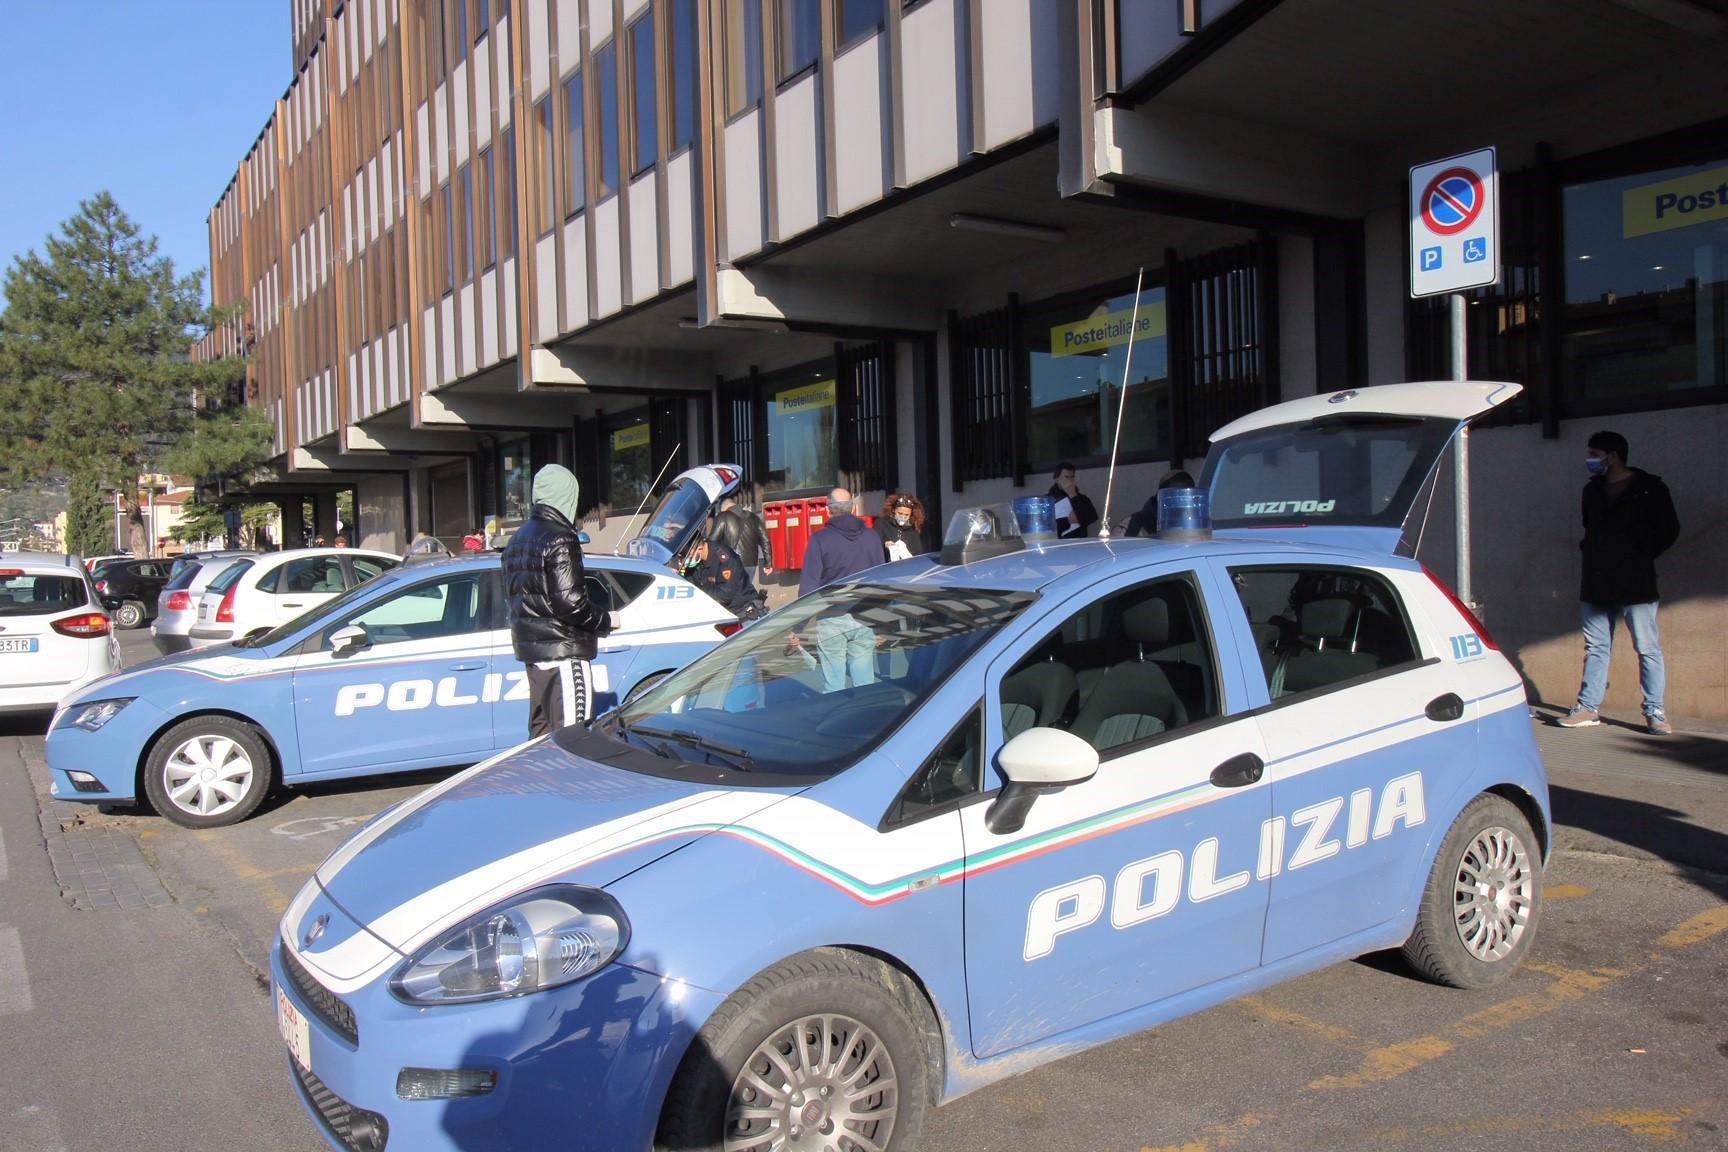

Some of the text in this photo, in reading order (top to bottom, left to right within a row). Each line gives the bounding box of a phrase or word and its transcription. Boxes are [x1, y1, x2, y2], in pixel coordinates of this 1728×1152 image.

[1425, 250, 1438, 269] P
[1065, 318, 1150, 348] Posteitaliane
[1244, 500, 1336, 515] POLIZIA
[657, 585, 695, 600] 113
[1449, 633, 1482, 659] 113
[334, 664, 609, 716] POLIZ
[1023, 770, 1427, 962] POLIZIA
